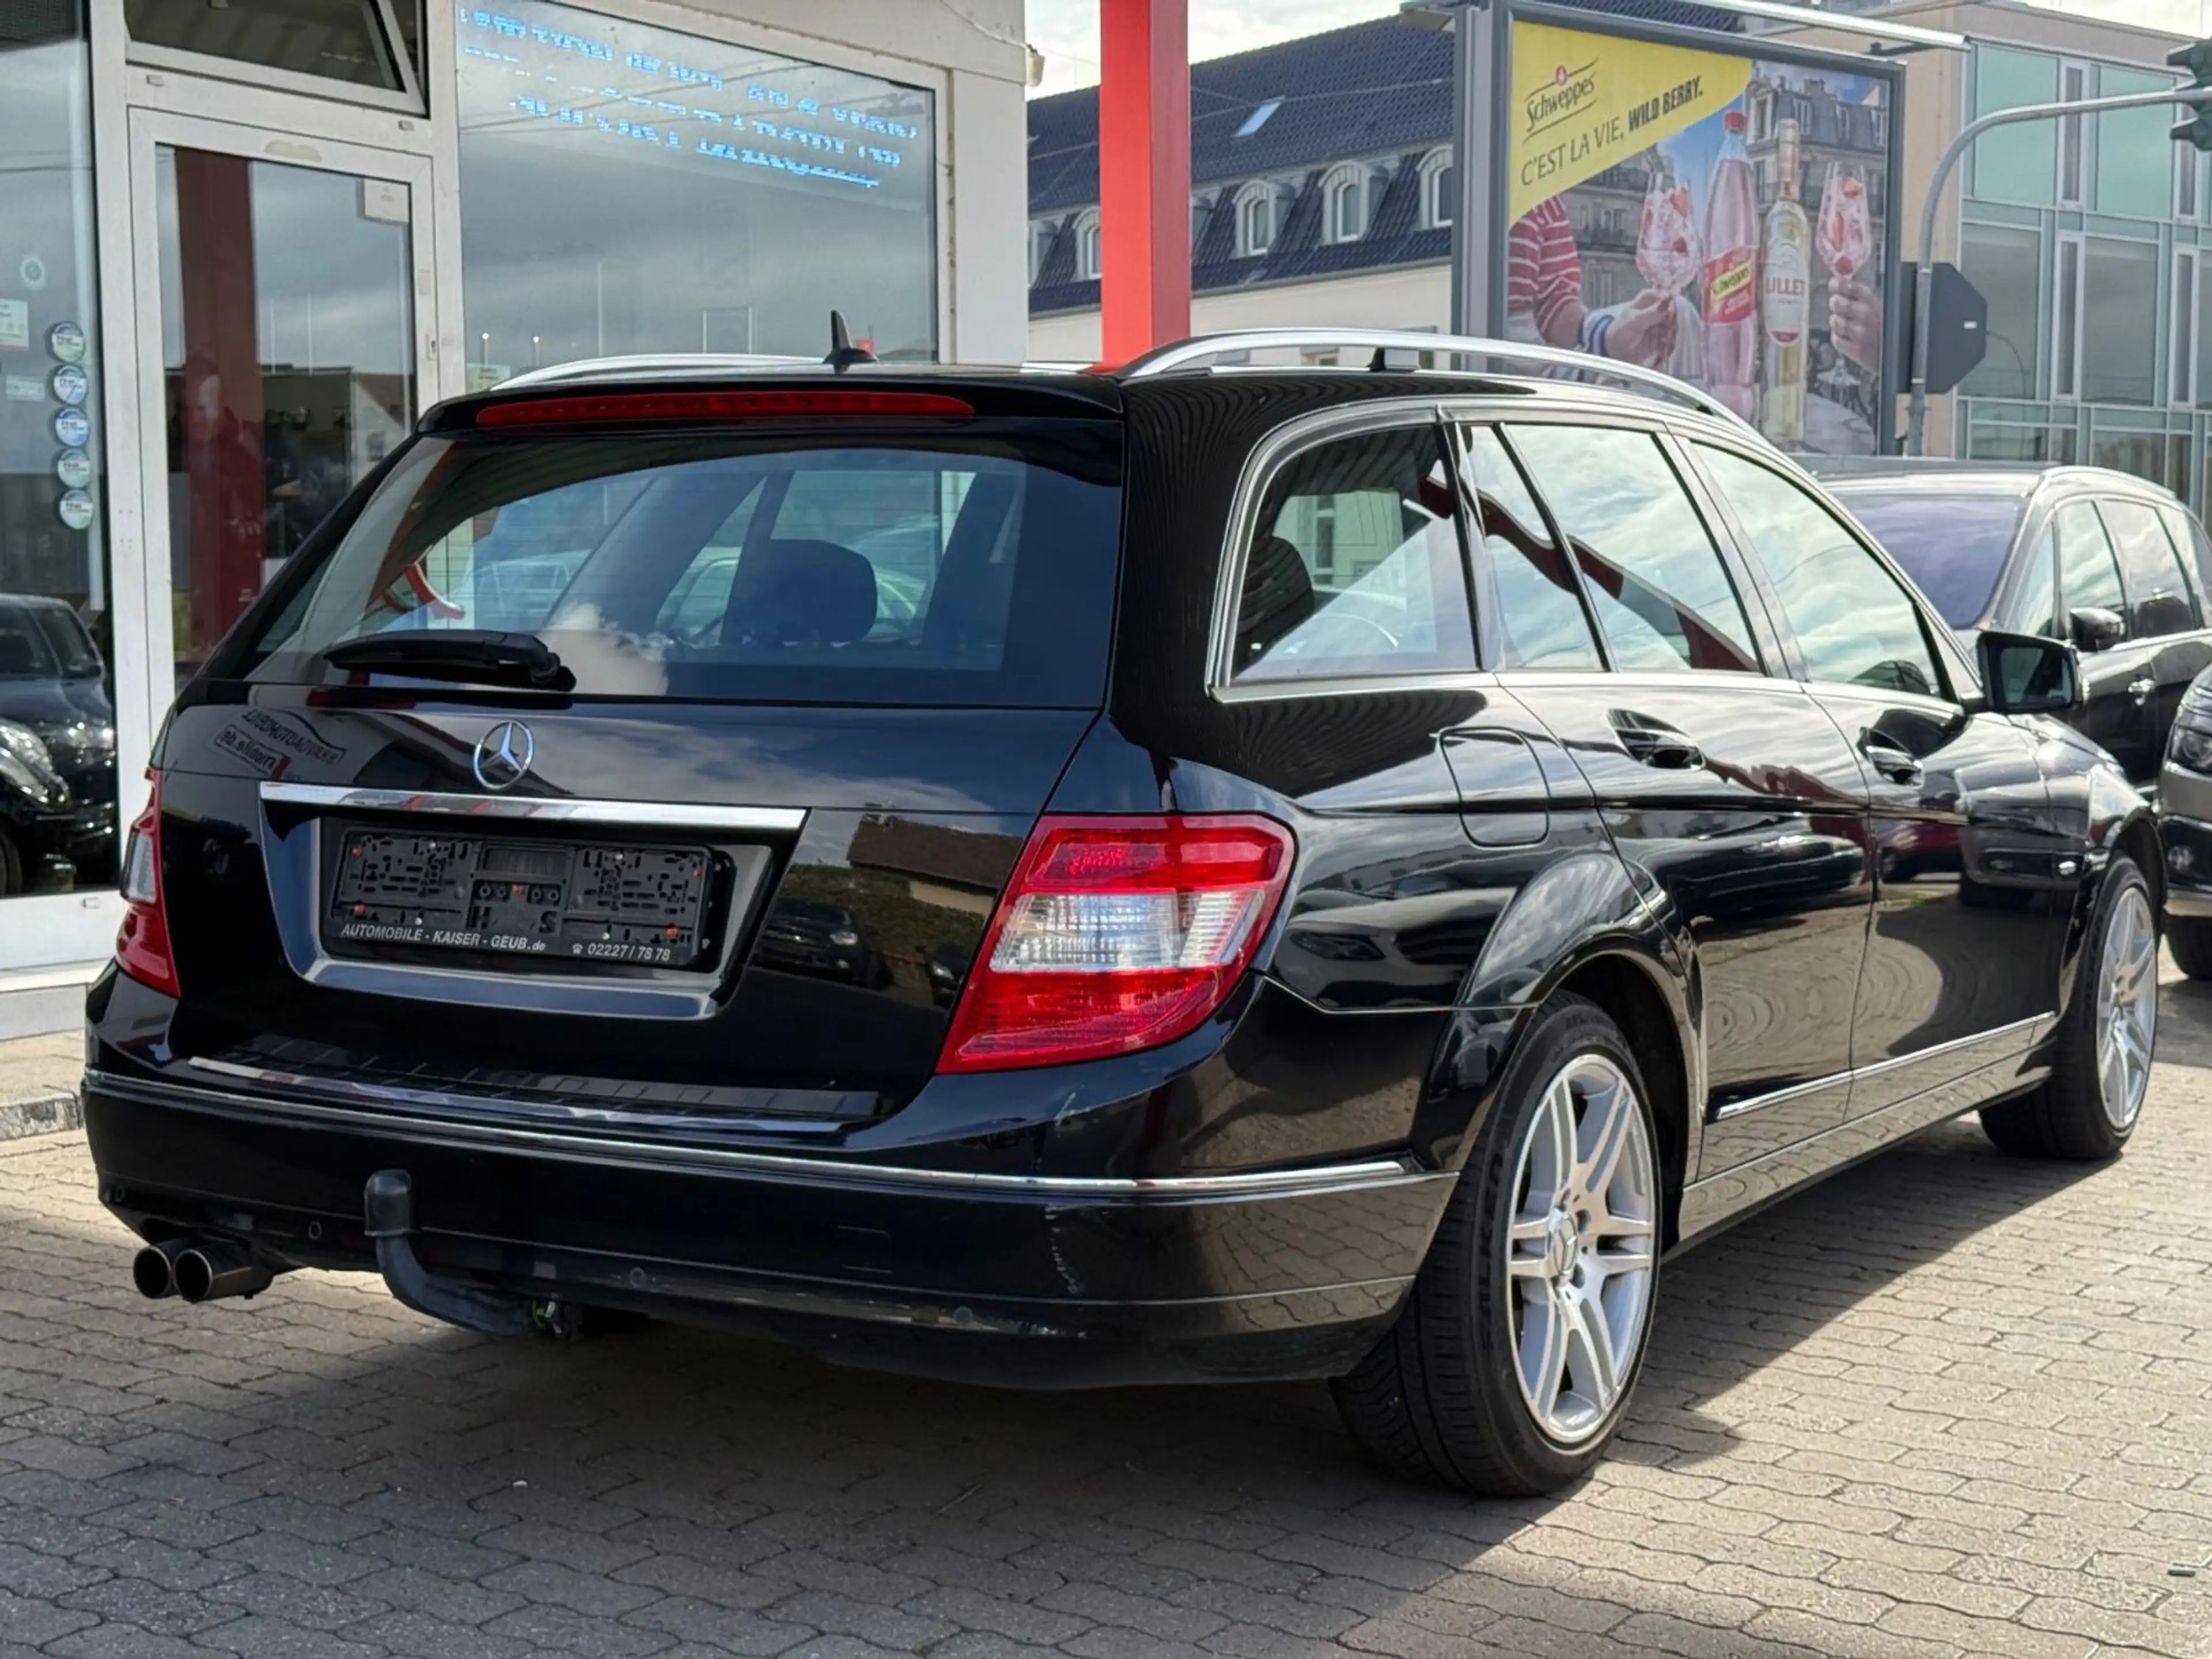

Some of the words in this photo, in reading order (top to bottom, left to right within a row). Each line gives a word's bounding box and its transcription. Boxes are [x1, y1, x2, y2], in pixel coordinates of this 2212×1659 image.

[1527, 72, 1597, 133] Schweppes
[1521, 143, 1566, 186] C'EST
[1571, 133, 1590, 163] LA
[1594, 117, 1624, 149] VIE,
[1628, 96, 1660, 132] WILD
[1662, 75, 1703, 116] BERRY.
[1766, 276, 1805, 297] LILLET
[341, 923, 424, 941] AUTOMOBILE
[433, 930, 480, 946] KAISER
[491, 934, 546, 951] GEUB.de
